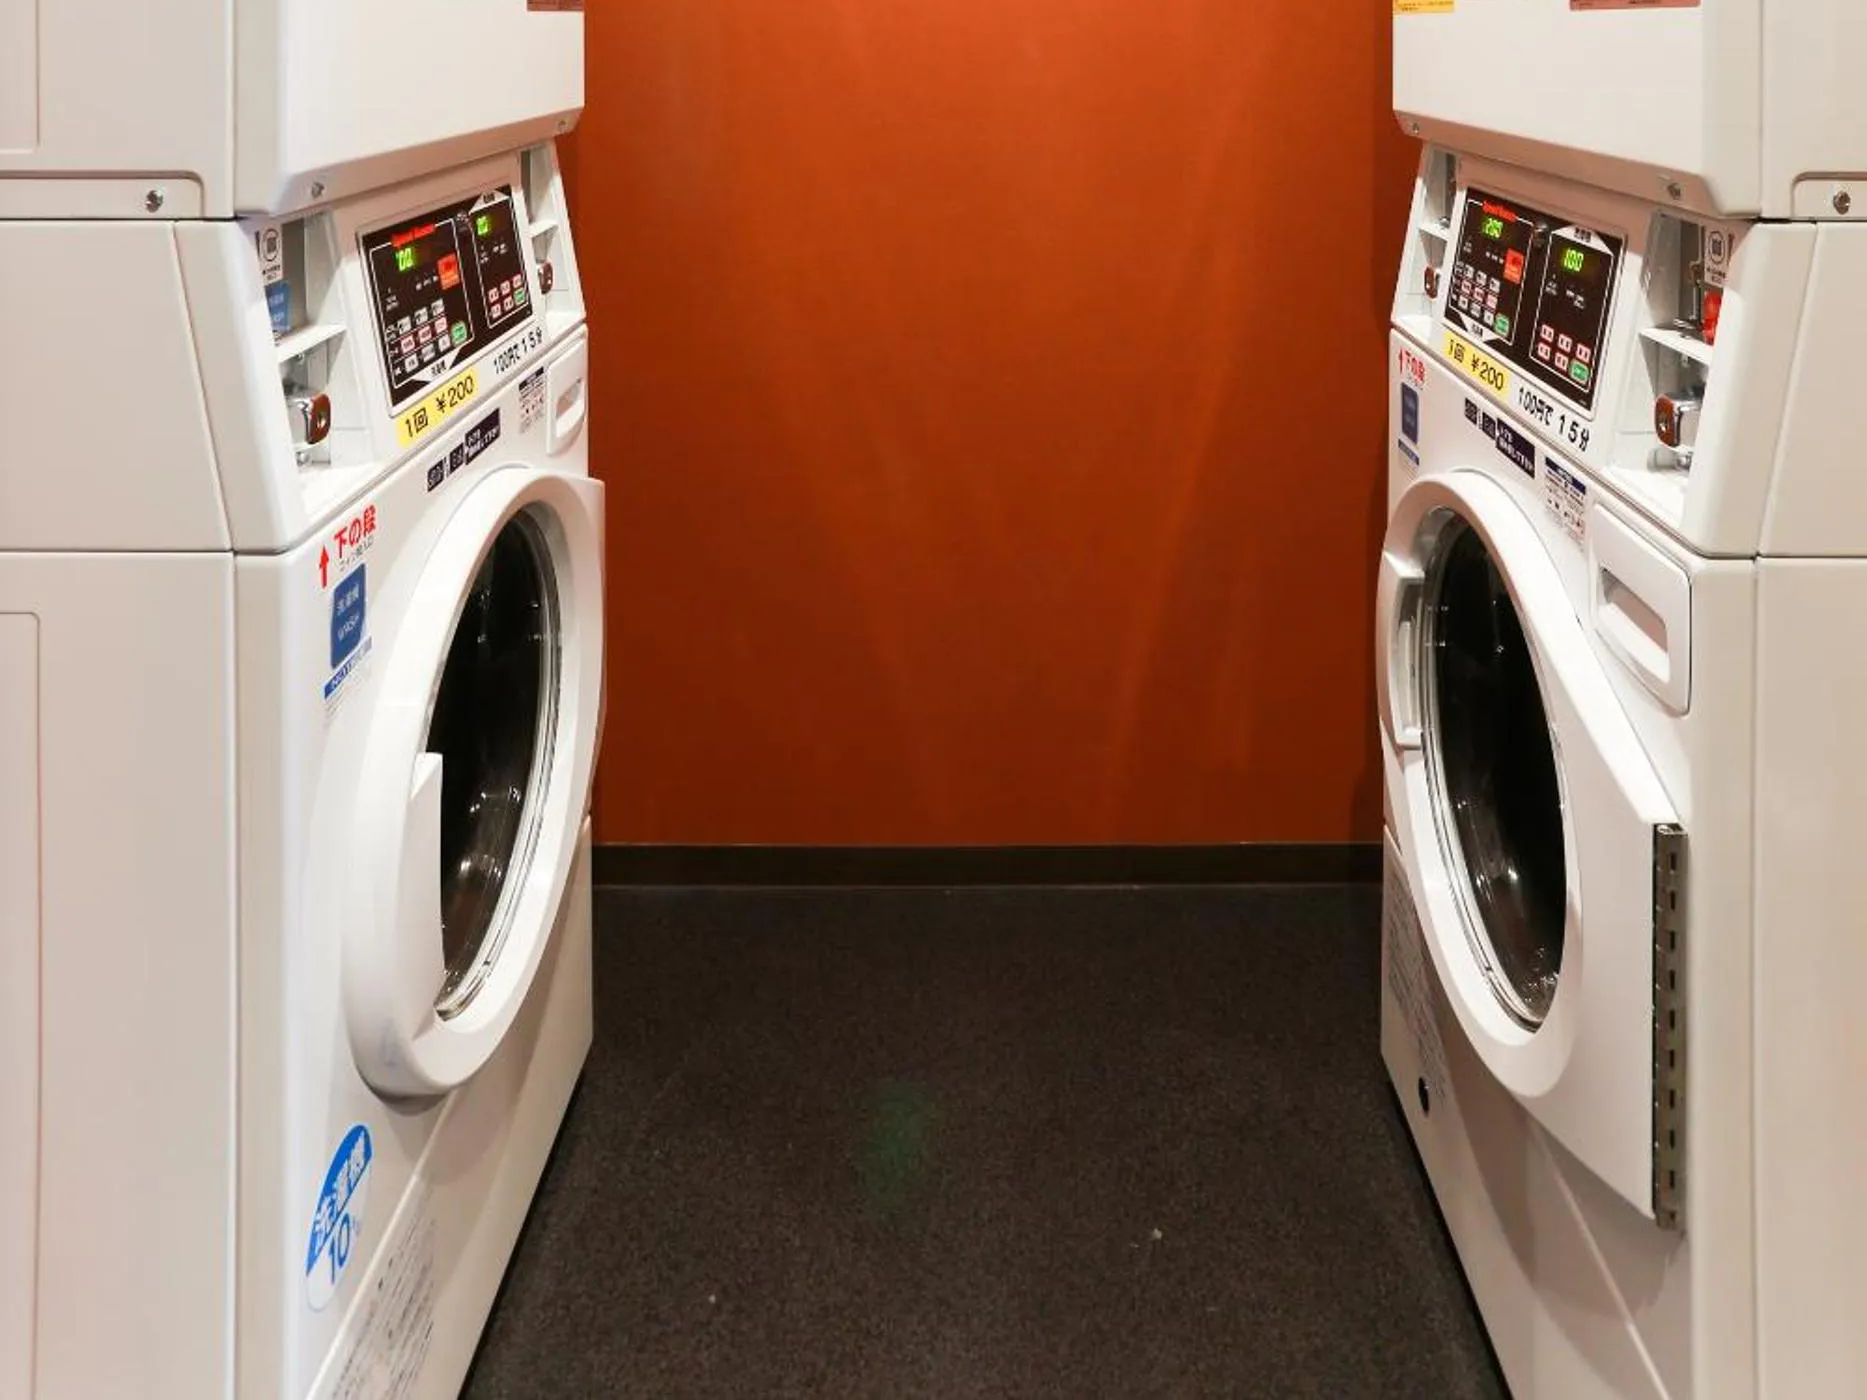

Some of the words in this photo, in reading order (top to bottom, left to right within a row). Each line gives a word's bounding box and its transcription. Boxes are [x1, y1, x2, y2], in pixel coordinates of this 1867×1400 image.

[1471, 353, 1505, 391] ¥200
[405, 407, 429, 438] 1回
[435, 375, 474, 414] ¥200
[335, 504, 376, 559] 下の段
[328, 1212, 350, 1284] 10
